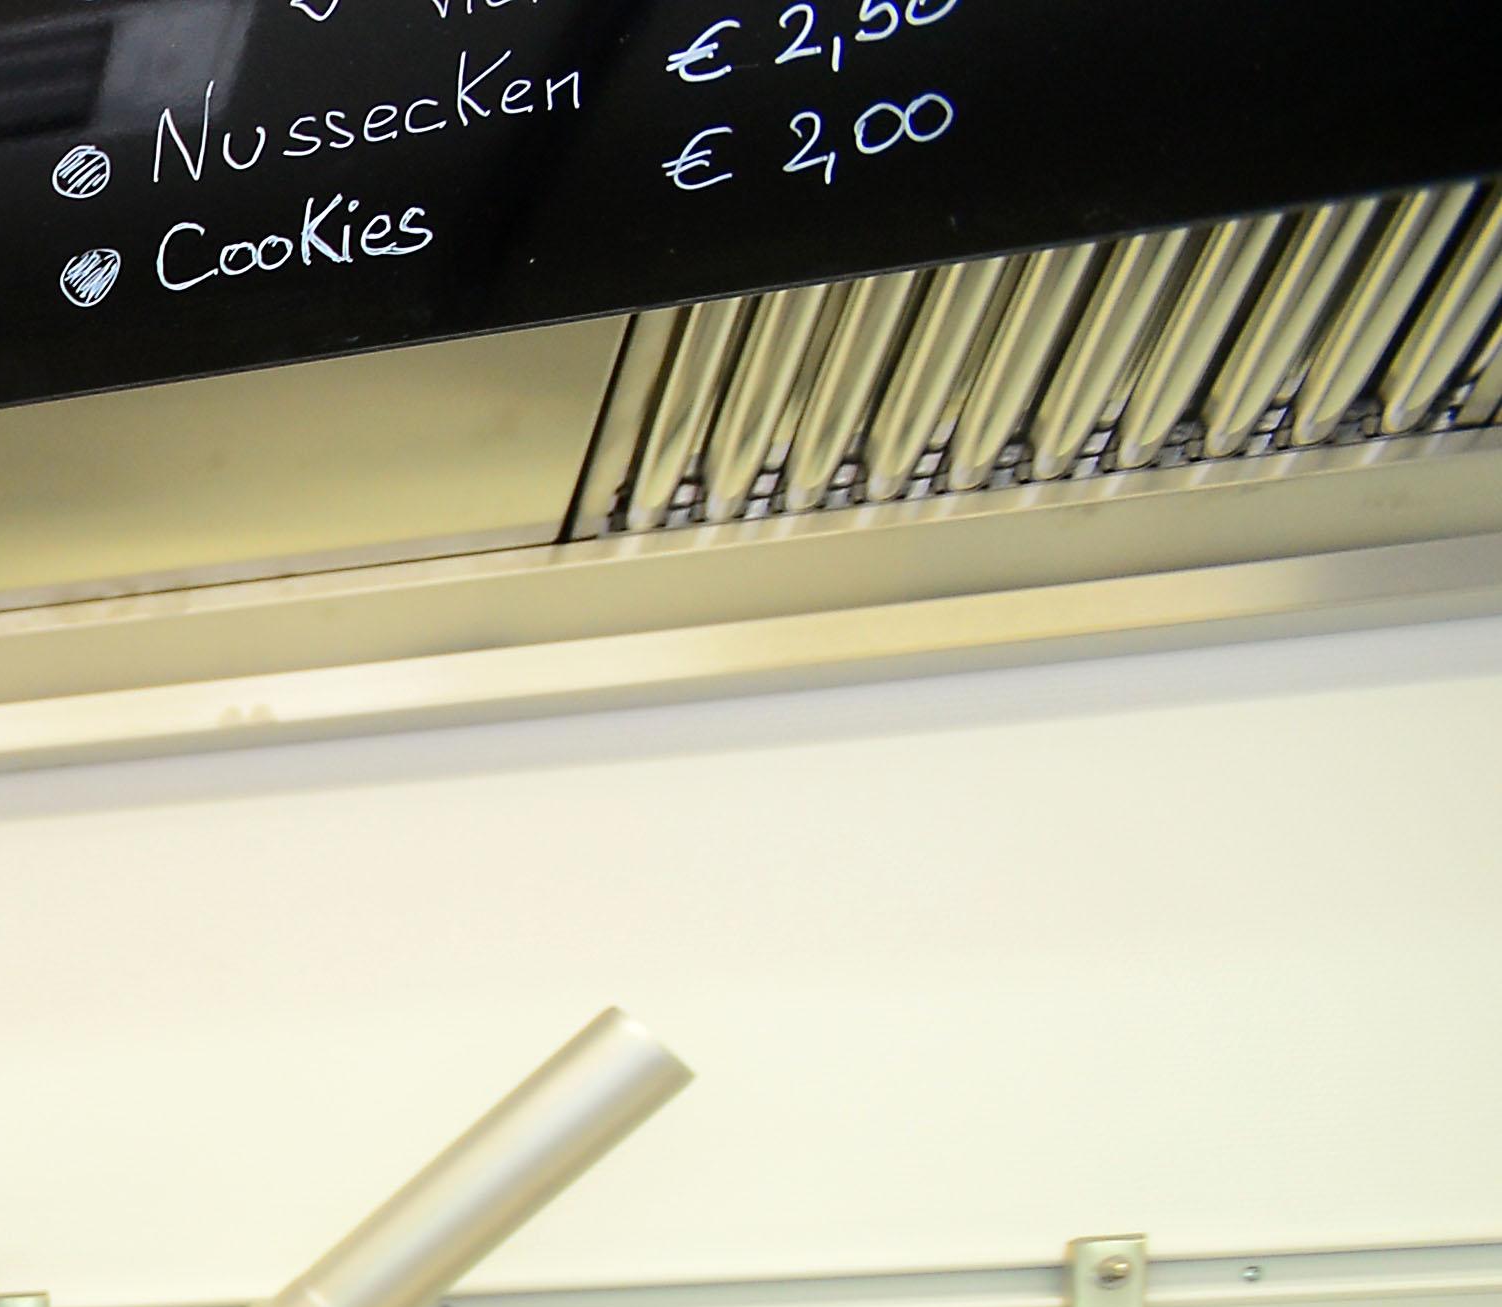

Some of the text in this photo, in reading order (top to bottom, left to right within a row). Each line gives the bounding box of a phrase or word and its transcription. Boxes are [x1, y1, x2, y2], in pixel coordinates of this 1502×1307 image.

[666, 19, 742, 82] €
[661, 93, 954, 190] € 2,00
